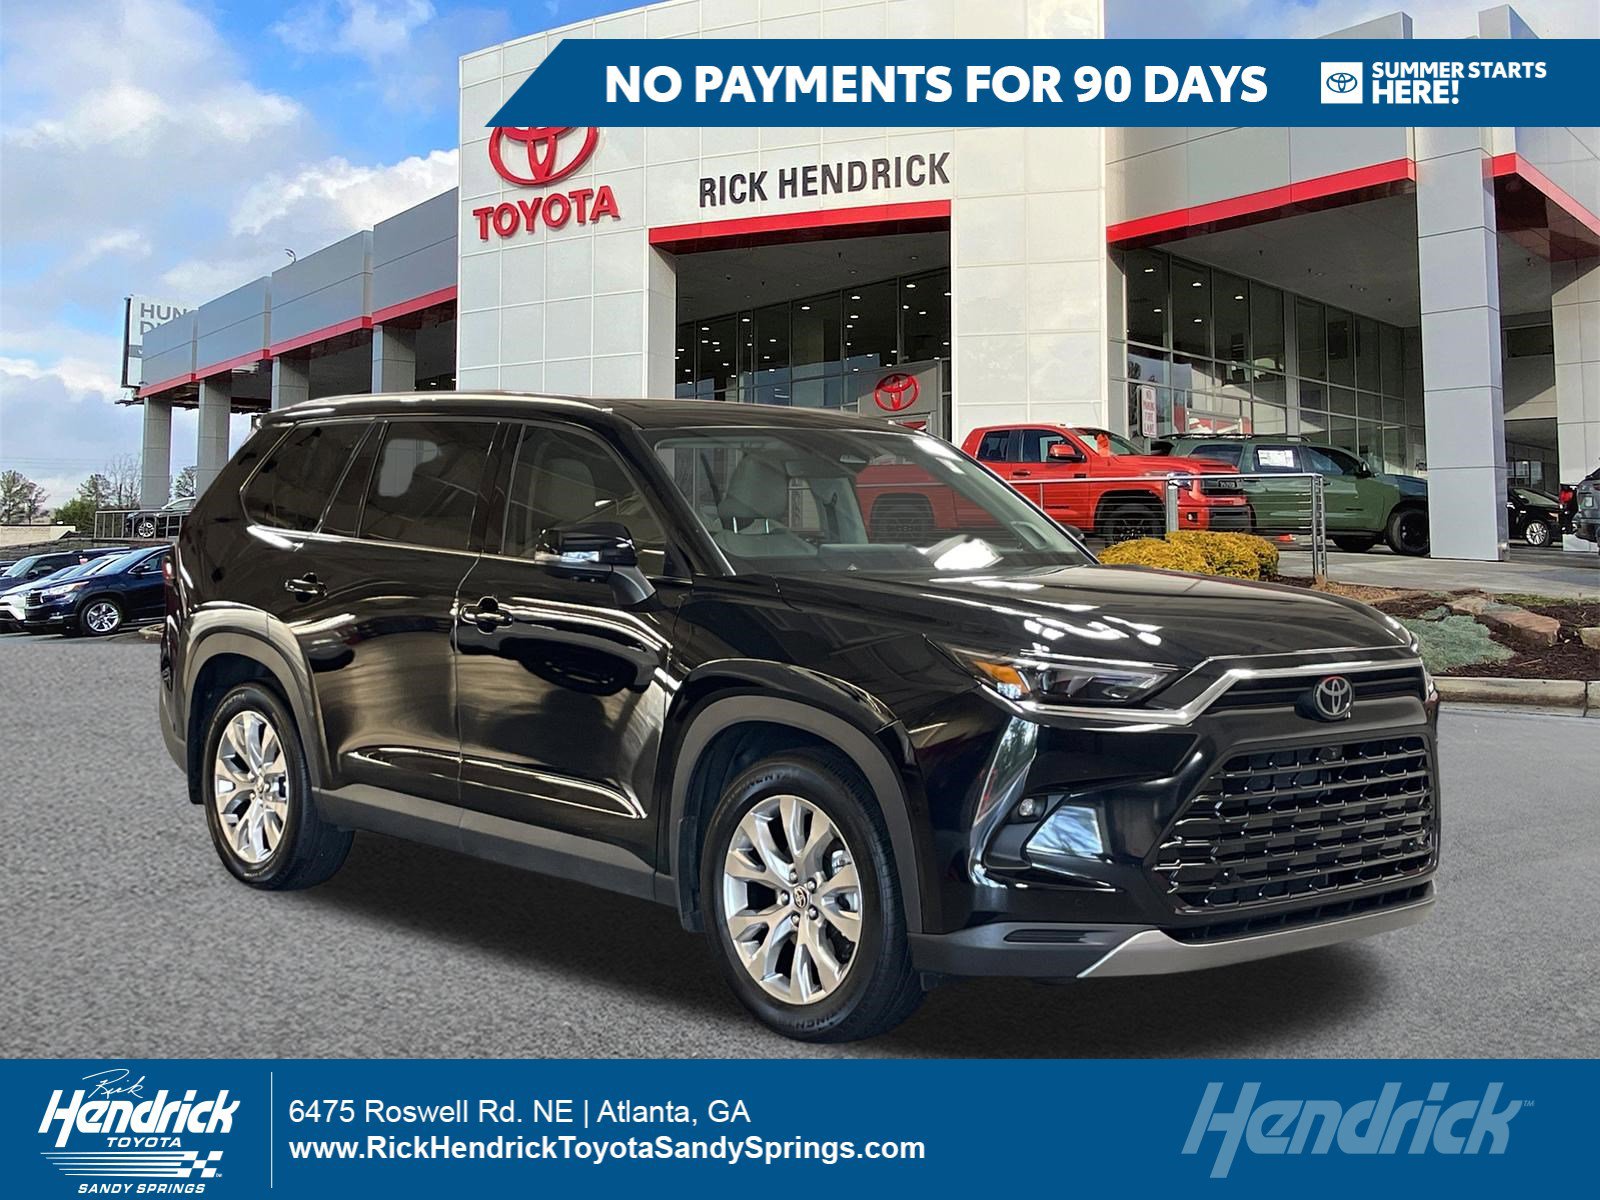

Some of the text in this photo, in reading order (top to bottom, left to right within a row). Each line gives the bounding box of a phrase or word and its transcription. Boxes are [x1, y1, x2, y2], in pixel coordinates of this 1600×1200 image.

[699, 151, 951, 208] RICK HENDRICK
[473, 185, 620, 241] TOYOTA
